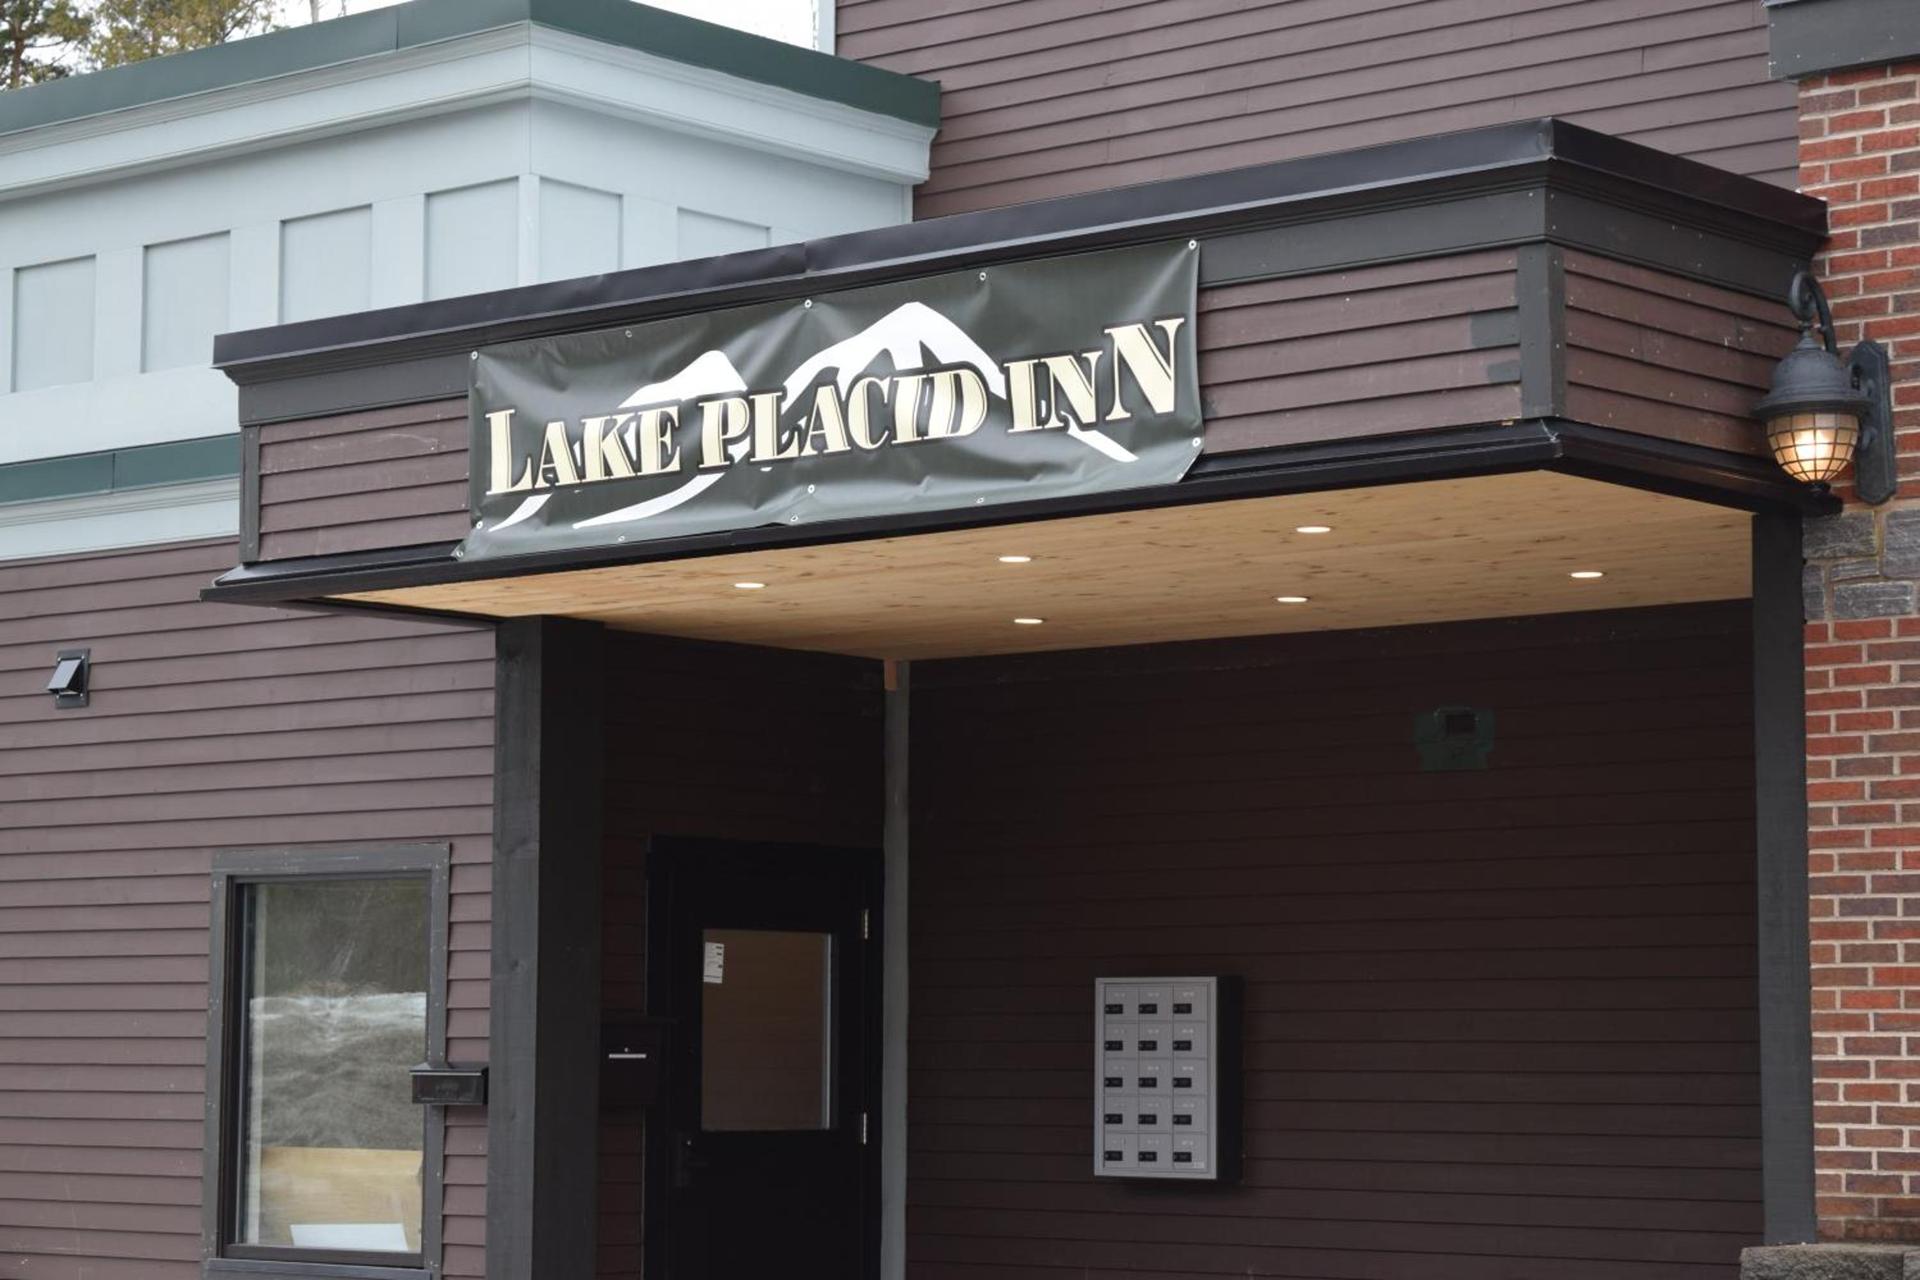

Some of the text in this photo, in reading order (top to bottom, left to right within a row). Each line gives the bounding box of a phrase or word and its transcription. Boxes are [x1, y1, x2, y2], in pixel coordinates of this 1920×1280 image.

[484, 317, 1187, 495] LAKE PLACID INN
